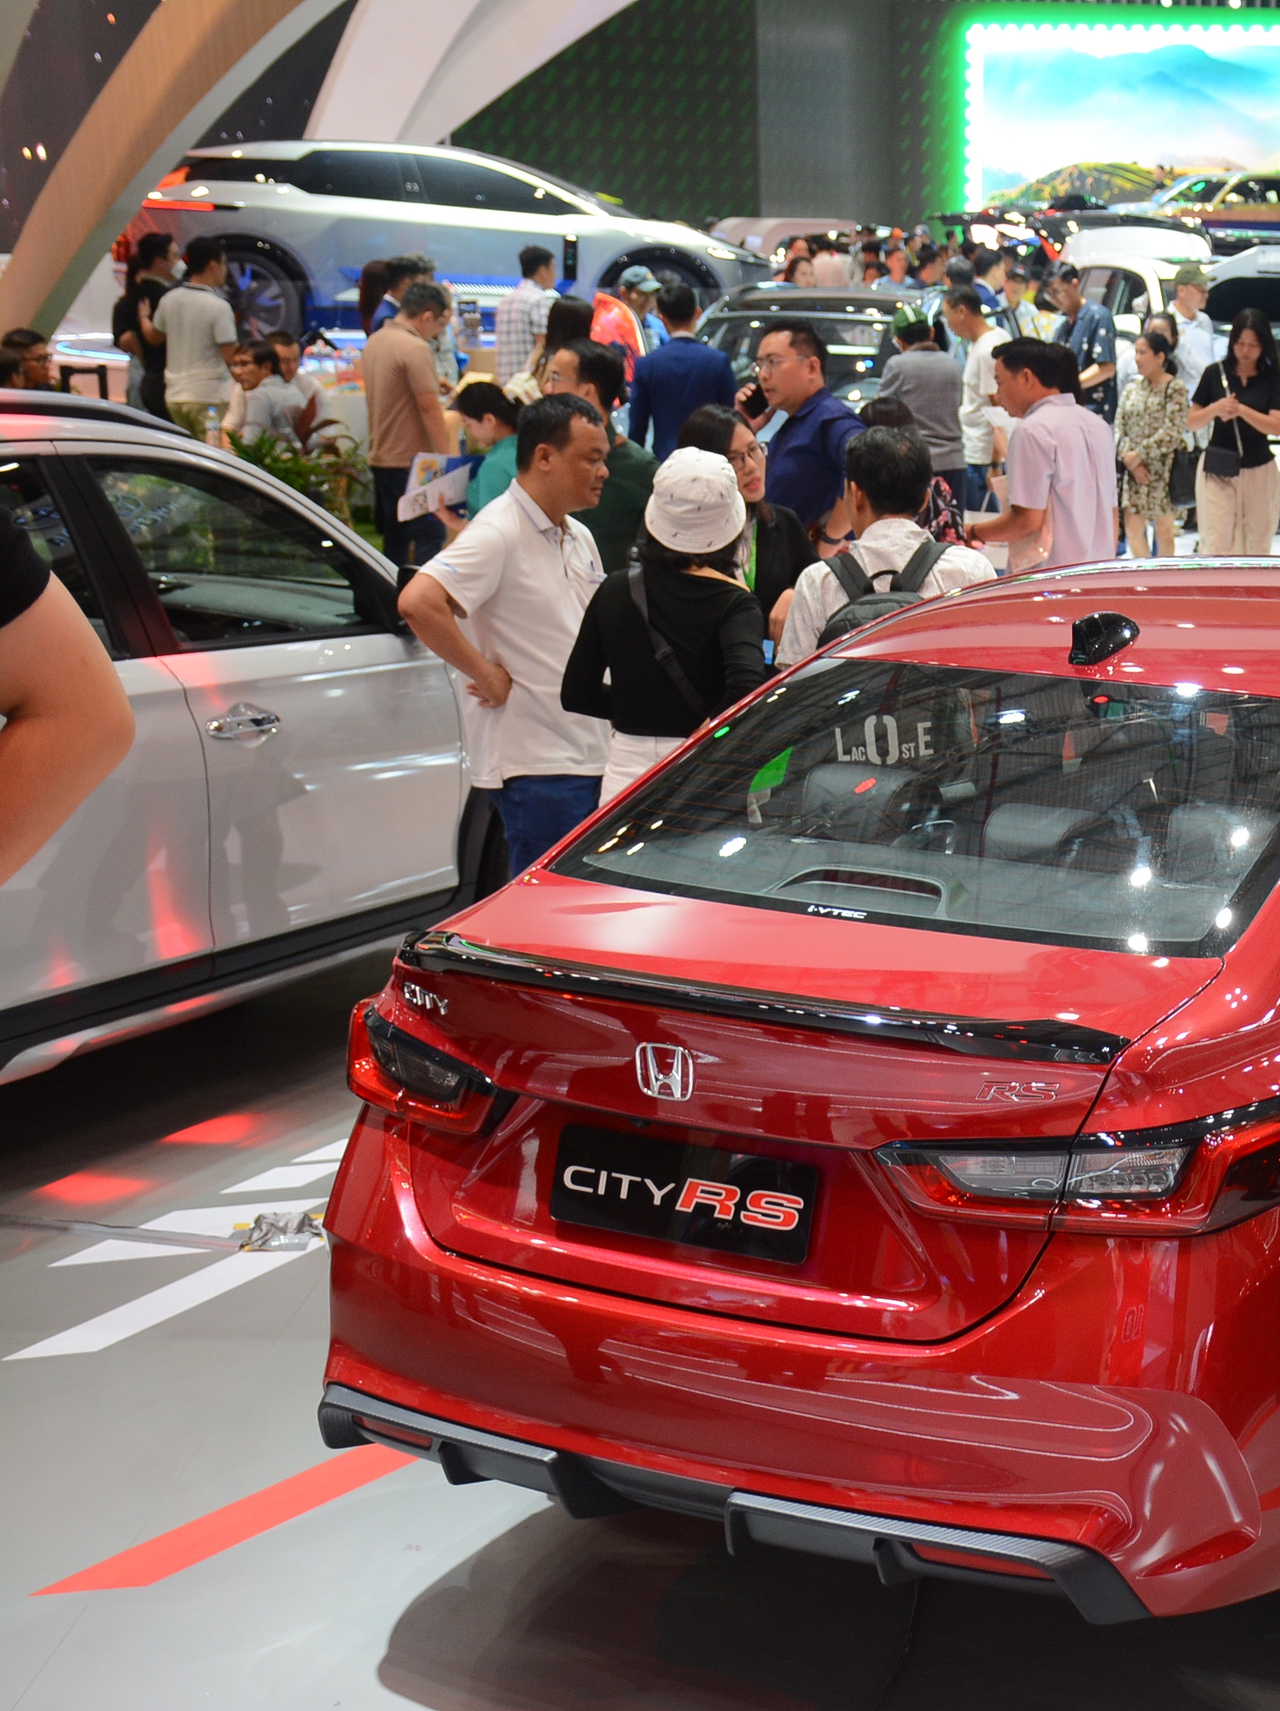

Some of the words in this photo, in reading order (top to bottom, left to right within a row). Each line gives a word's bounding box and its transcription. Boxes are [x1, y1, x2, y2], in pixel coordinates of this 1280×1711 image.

[404, 981, 449, 1016] CITY
[975, 1081, 1060, 1103] RS
[563, 1165, 676, 1206] CITY
[675, 1177, 804, 1231] RS
